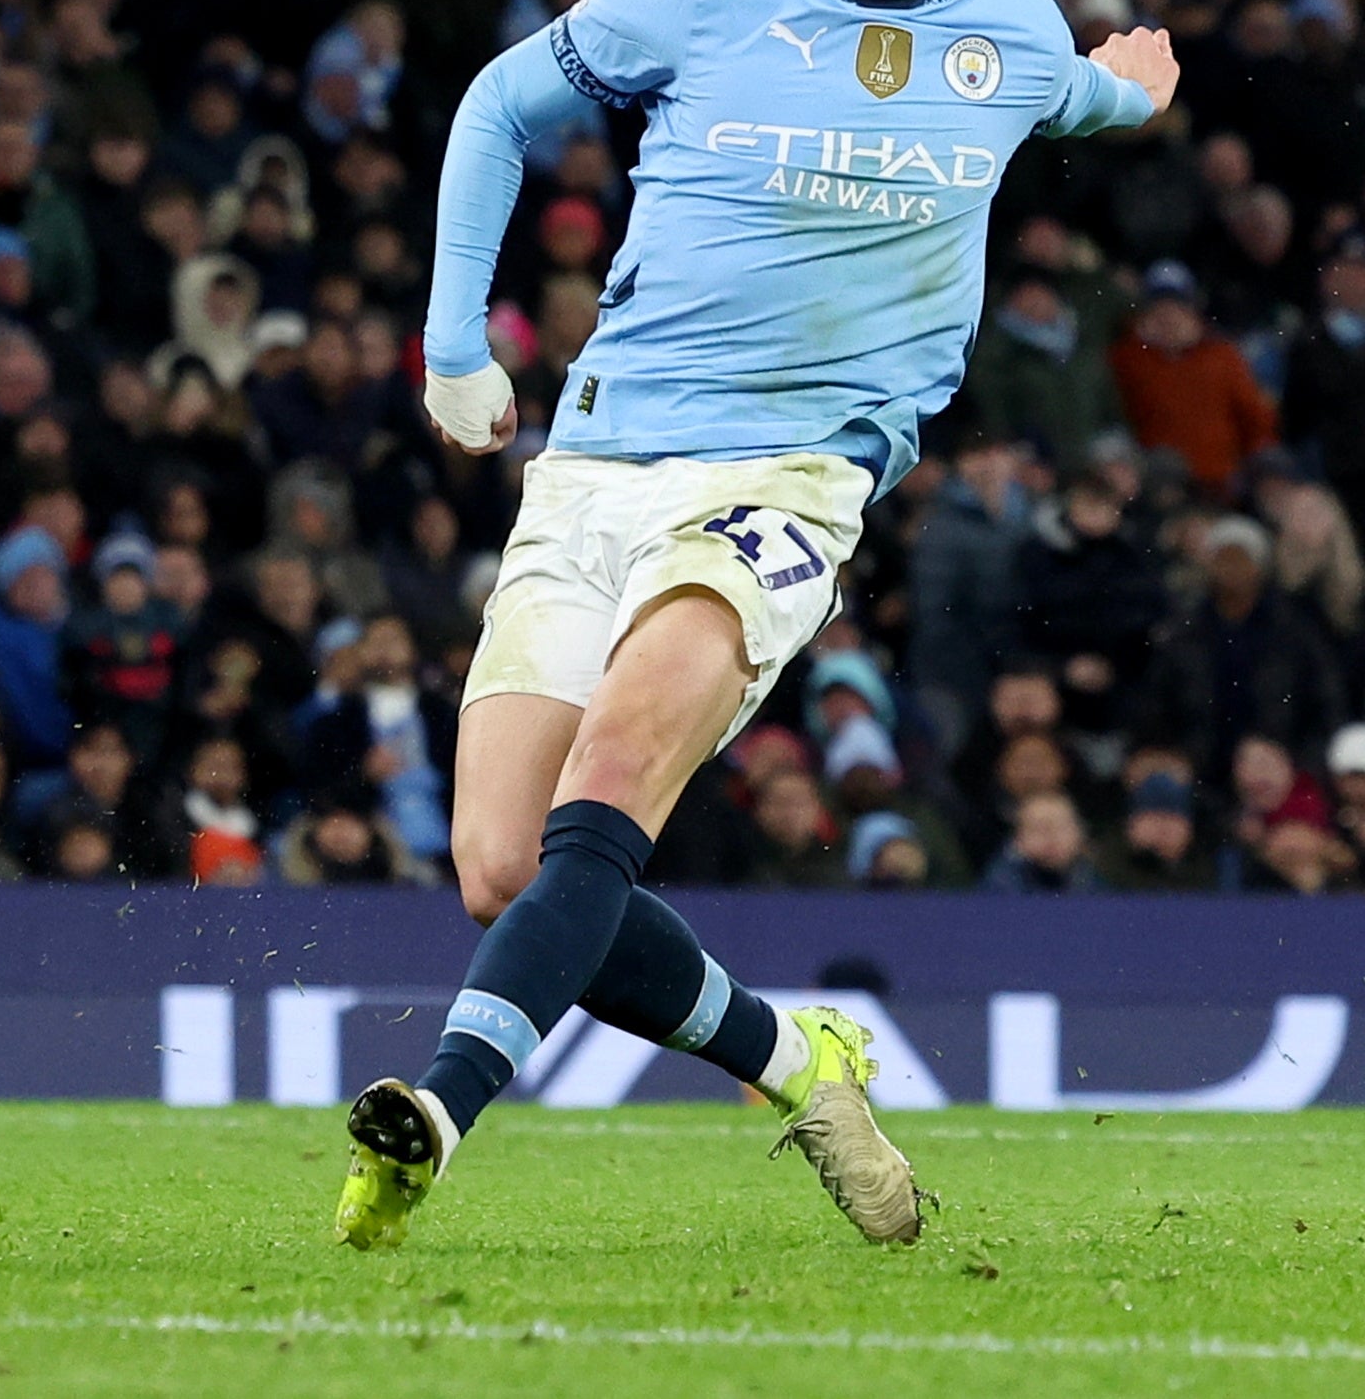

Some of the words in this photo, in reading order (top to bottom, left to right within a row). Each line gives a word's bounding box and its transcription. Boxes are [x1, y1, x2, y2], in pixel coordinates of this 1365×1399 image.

[951, 39, 997, 64] MANCHESTER
[870, 71, 895, 84] FIFA
[706, 120, 997, 188] ETIHAD
[763, 168, 938, 224] AIRWAYS
[703, 504, 827, 592] 47
[459, 1002, 514, 1031] CITY
